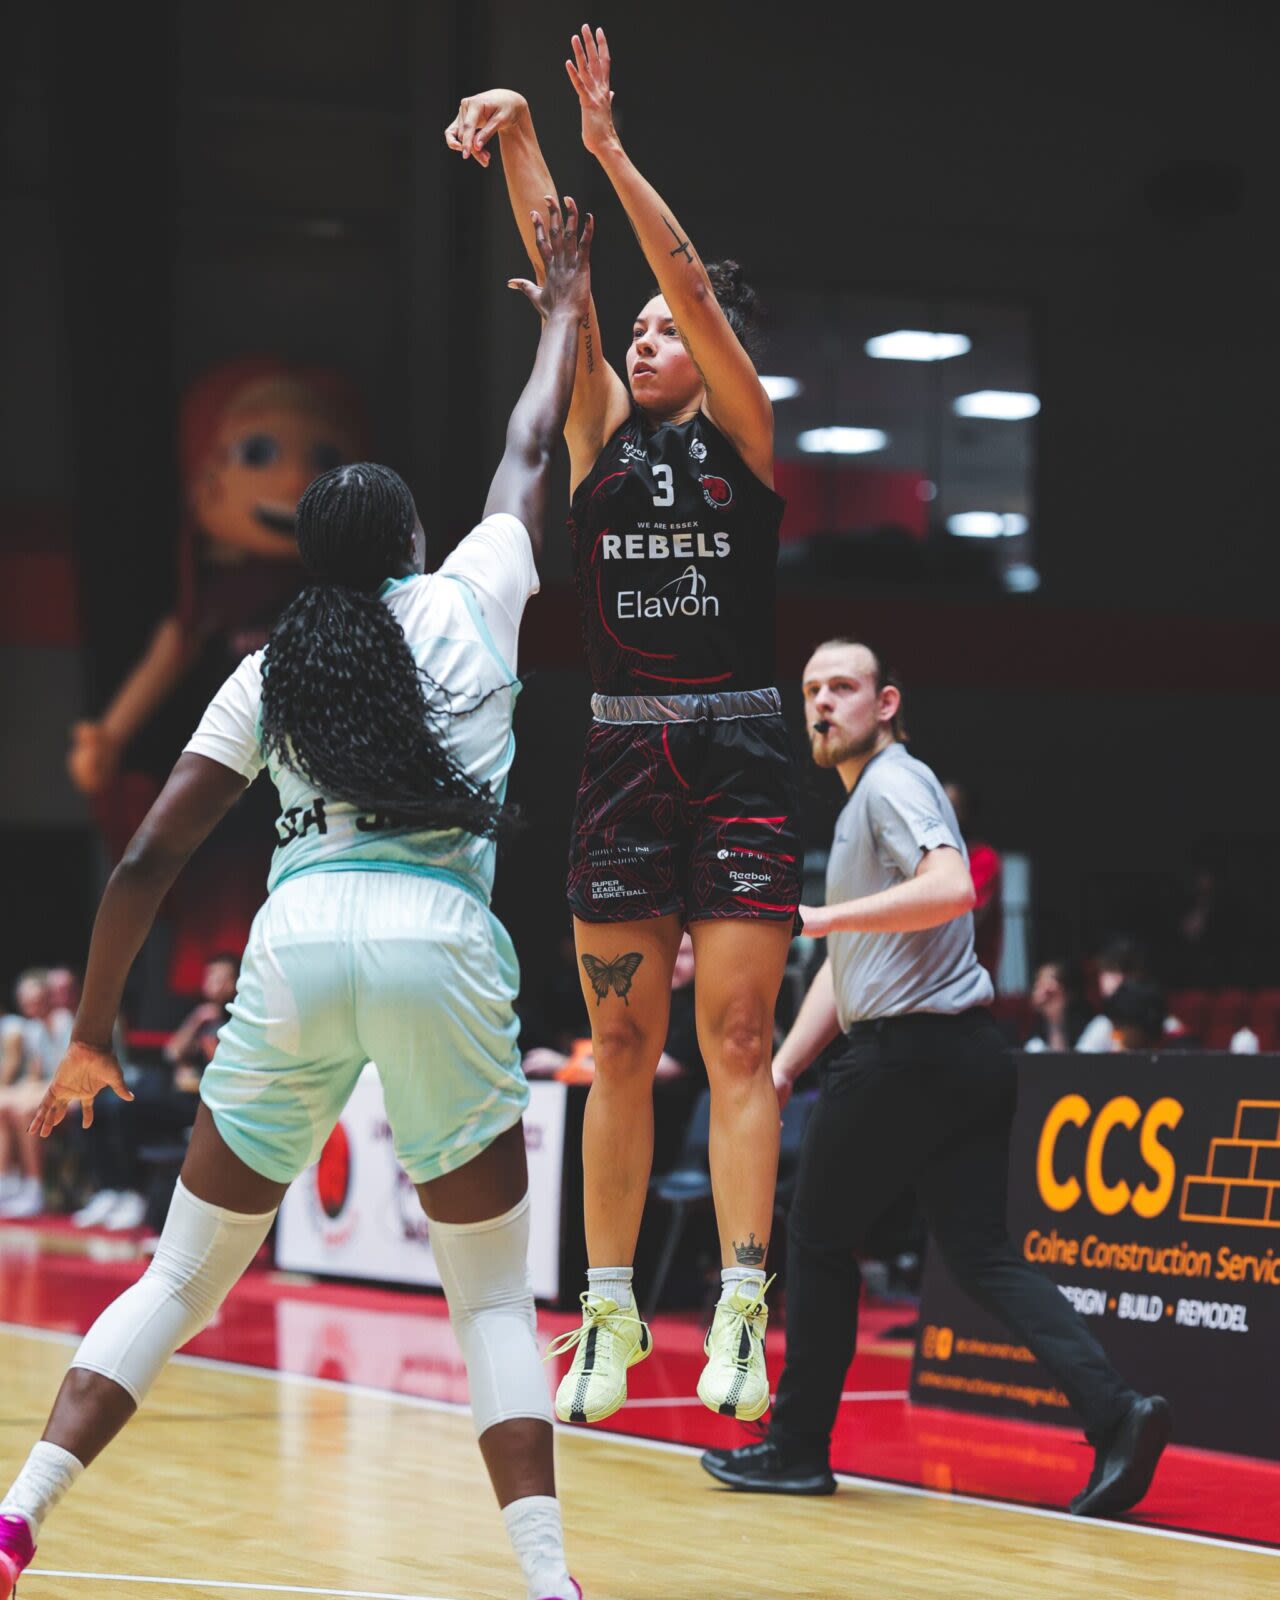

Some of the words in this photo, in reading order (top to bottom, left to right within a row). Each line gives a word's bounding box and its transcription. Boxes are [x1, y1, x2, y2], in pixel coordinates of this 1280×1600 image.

[651, 463, 675, 507] 3
[637, 521, 651, 529] WE
[653, 522, 667, 530] ARE
[670, 520, 699, 530] ESSEX
[602, 531, 731, 560] REBELS
[617, 590, 719, 619] Elavon
[592, 885, 625, 893] LEAGUE
[729, 871, 772, 882] Reebok
[592, 889, 648, 899] BASKETBALL
[1036, 1093, 1184, 1219] CCS
[1023, 1229, 1079, 1266] Colne
[1080, 1234, 1212, 1278] Construction
[1117, 1292, 1164, 1323] BUILD
[1175, 1298, 1249, 1333] REMODEL
